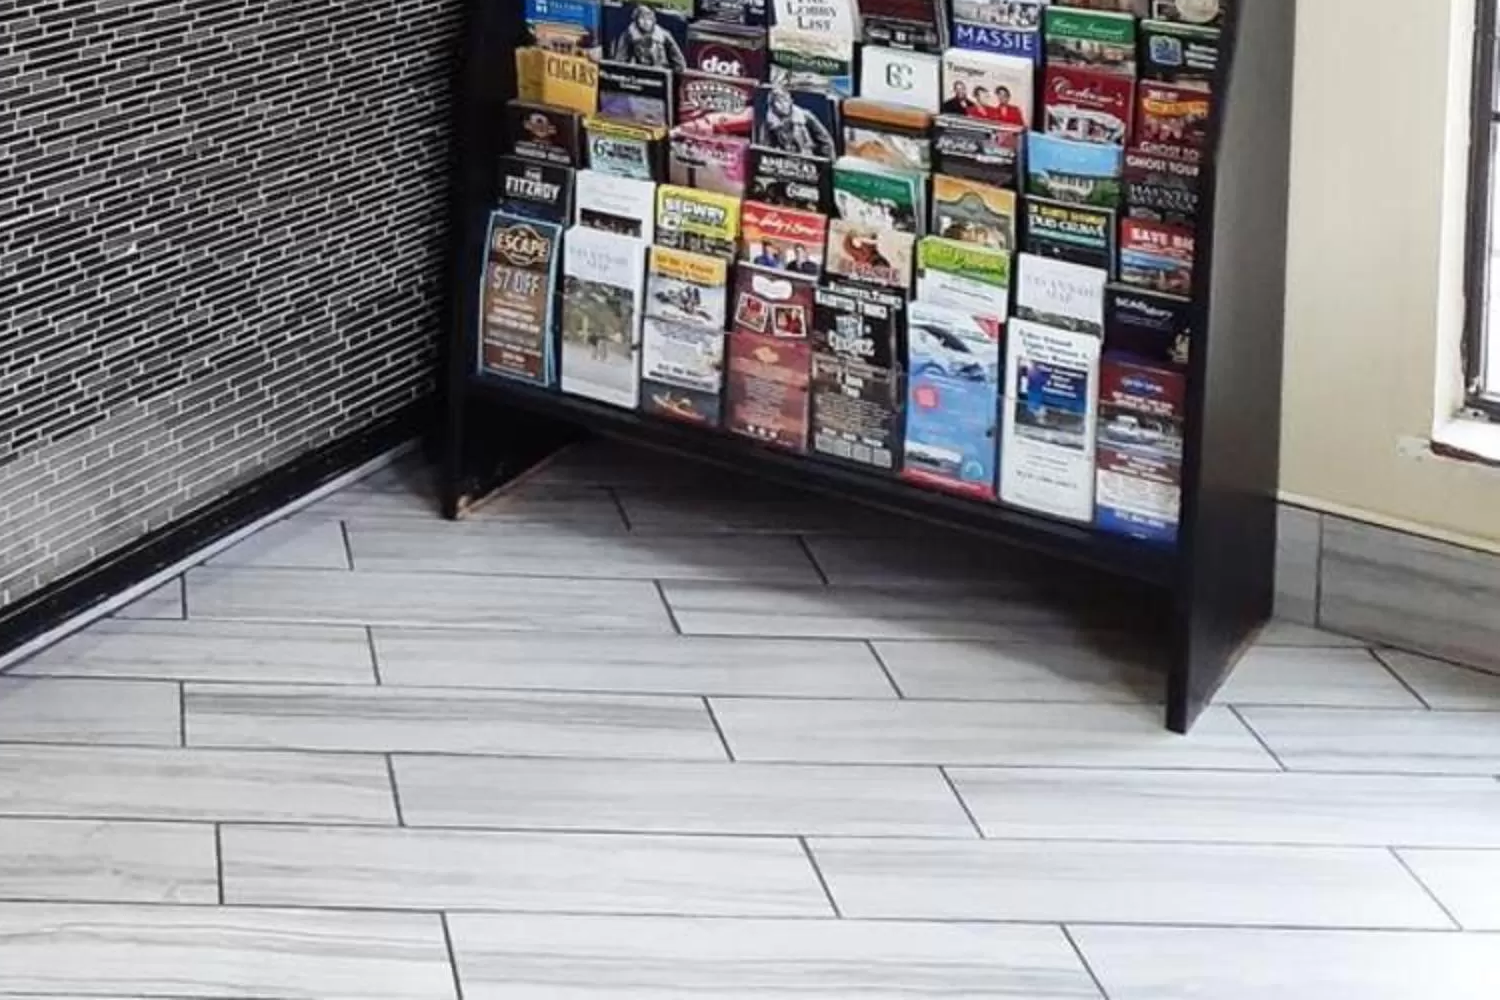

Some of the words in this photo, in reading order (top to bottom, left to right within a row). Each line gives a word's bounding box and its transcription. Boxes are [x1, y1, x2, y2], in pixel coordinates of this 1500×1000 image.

[798, 15, 832, 32] LIST
[957, 23, 1033, 52] MASSIE
[702, 55, 741, 77] dot
[1125, 155, 1167, 171] GHOST
[505, 175, 560, 200] FITZROY
[496, 231, 550, 258] ESCAPE
[1131, 227, 1168, 246] SAVE
[492, 267, 512, 290] $7
[513, 272, 540, 296] OFF
